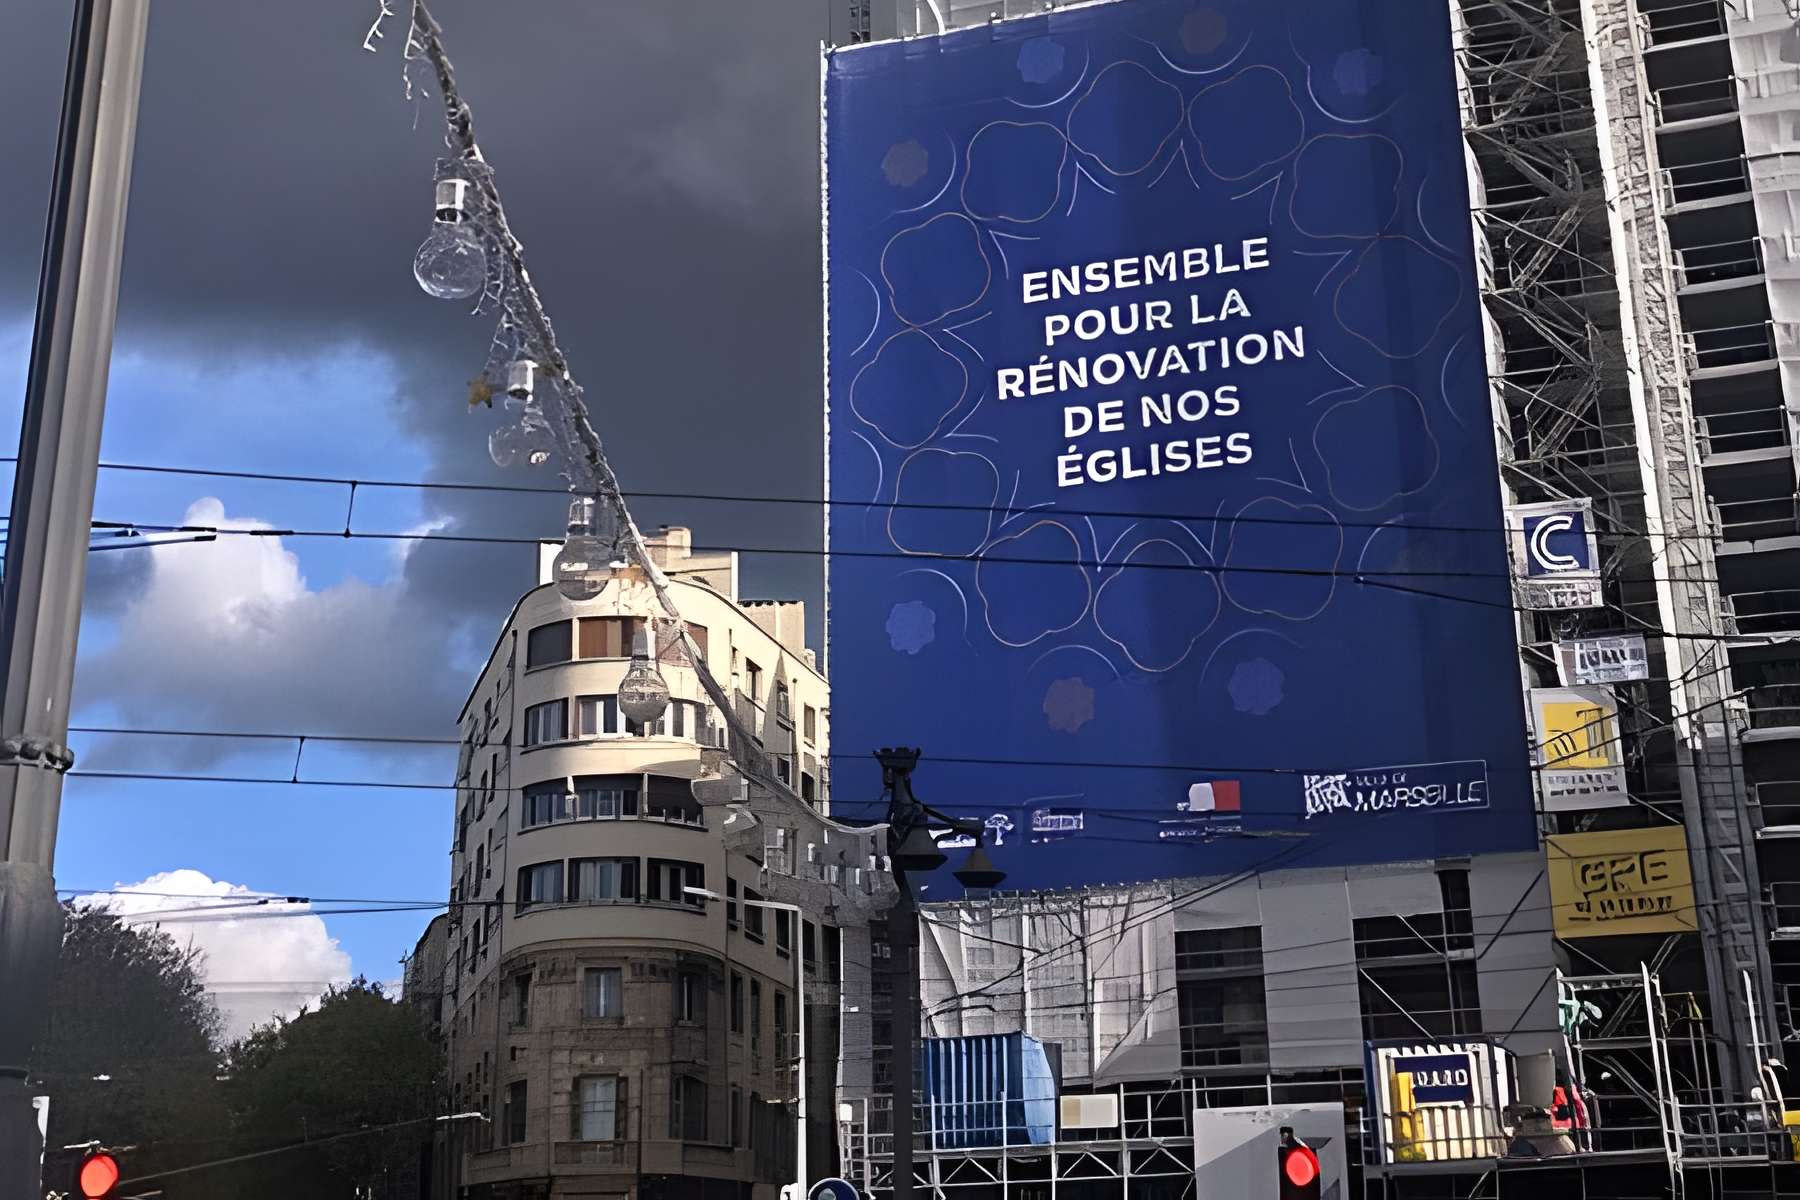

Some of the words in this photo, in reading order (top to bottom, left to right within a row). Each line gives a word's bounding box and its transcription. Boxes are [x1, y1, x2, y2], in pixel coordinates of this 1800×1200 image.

[1022, 237, 1270, 304] ENSEMBLE
[1045, 300, 1174, 346] POUR
[1190, 288, 1252, 325] LA
[997, 326, 1305, 400] RÉNOVATION
[1064, 400, 1125, 438] DE
[1141, 385, 1241, 428] NOS
[1057, 432, 1253, 487] ÉGLISES
